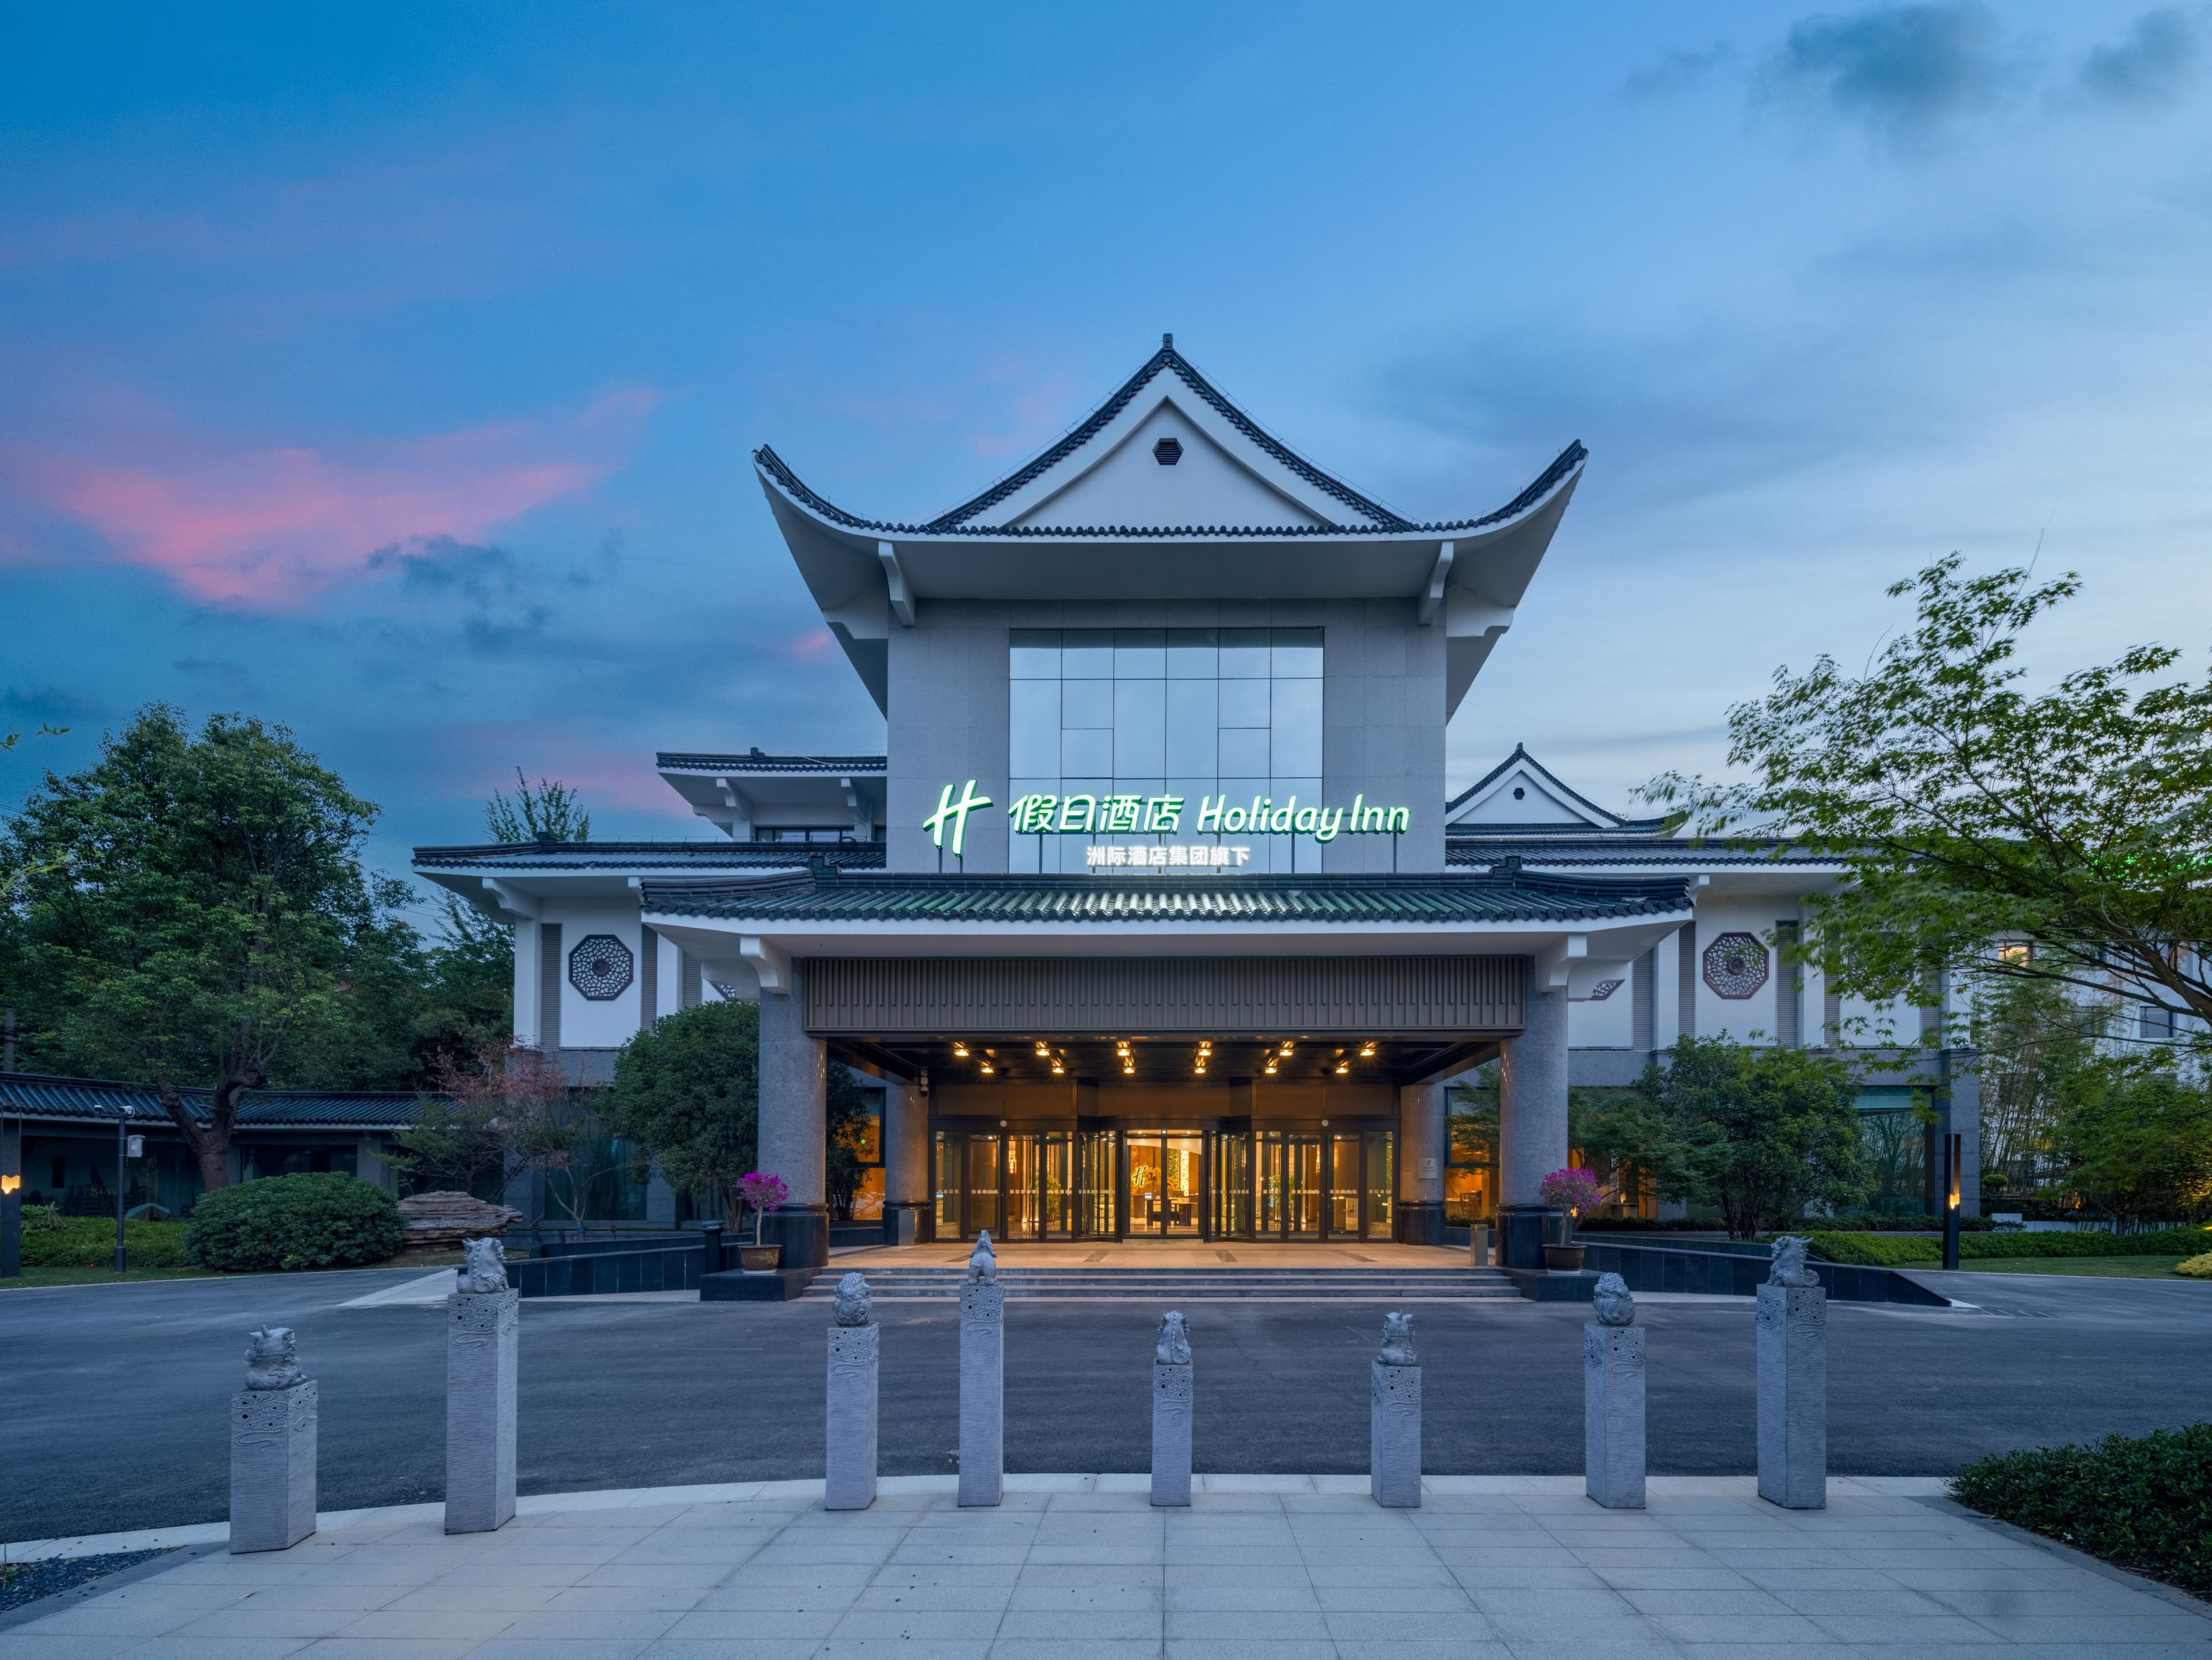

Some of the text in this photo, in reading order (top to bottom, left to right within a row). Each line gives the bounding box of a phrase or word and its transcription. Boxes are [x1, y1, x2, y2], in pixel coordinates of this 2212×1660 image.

[1008, 794, 1184, 834] 假日酒店
[1197, 794, 1410, 843] Holiday Inn
[1087, 846, 1250, 865] 洲际酒店集团旗下
